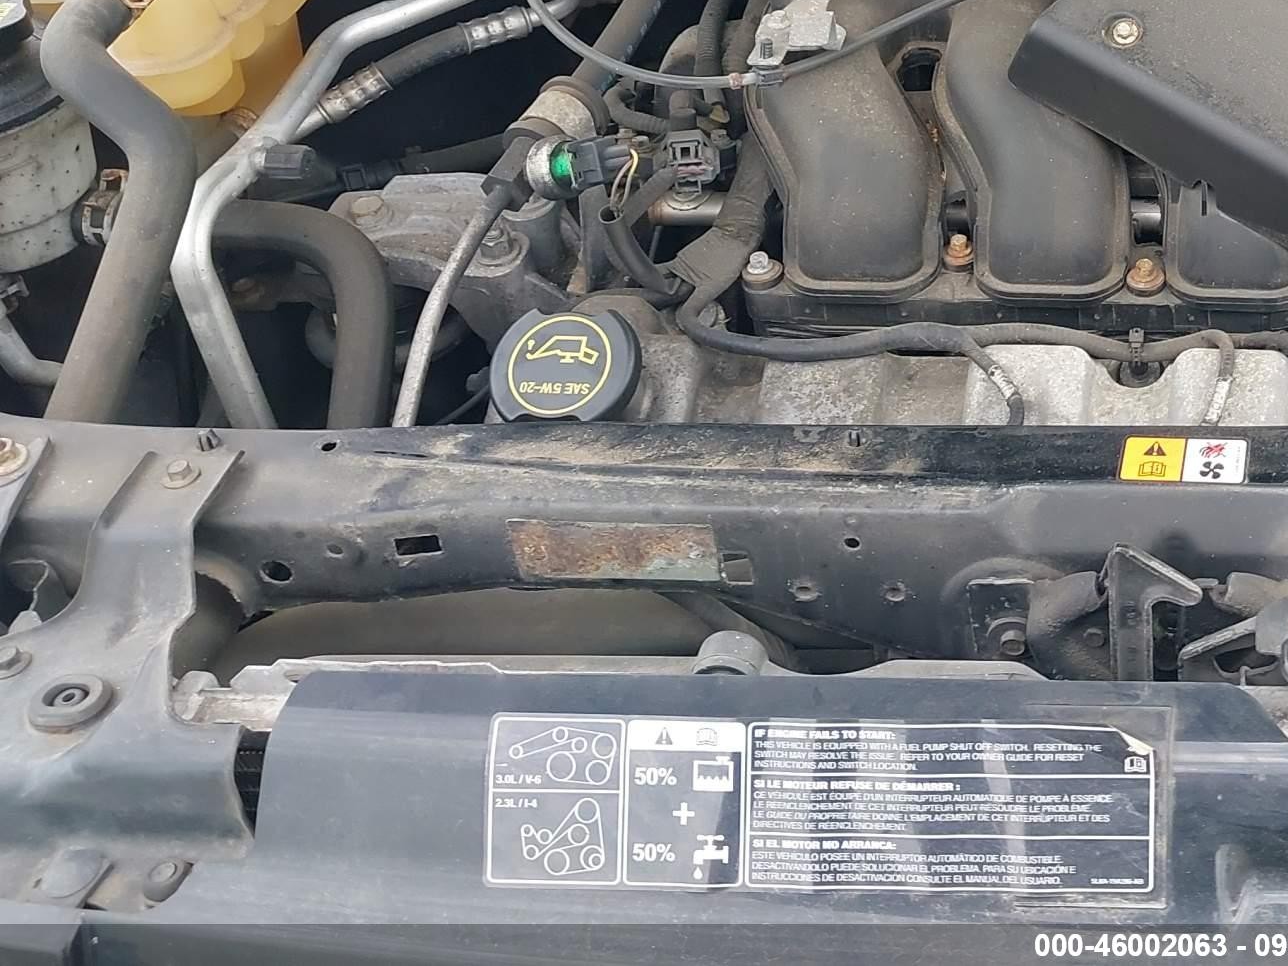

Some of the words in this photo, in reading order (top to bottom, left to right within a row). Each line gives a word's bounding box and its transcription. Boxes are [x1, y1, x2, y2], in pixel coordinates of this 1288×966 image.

[519, 381, 561, 394] 5W-20
[563, 383, 591, 395] SAE
[755, 729, 766, 738] IF
[809, 730, 839, 739] FAILS
[842, 730, 857, 739] TO
[859, 730, 896, 740] START:
[755, 741, 774, 749] THIS
[776, 741, 810, 749] VEHICLE
[824, 742, 867, 750] EQUIPPED
[869, 743, 892, 751] WITH
[899, 743, 921, 751] FUEL
[923, 743, 948, 751] PUMP
[950, 743, 973, 751] SHUT
[975, 743, 993, 751] OFF
[1034, 743, 1083, 751] RESETTING
[1086, 744, 1102, 752] THE
[755, 751, 787, 759] SWITCH
[790, 751, 807, 759] MAY
[808, 752, 848, 760] RESOLVE
[932, 753, 944, 761] TO
[945, 753, 970, 761] YOUR
[972, 753, 1004, 761] OWNER
[755, 760, 816, 769] INSTRUCTIONS
[495, 774, 517, 784] 3.0L
[525, 774, 542, 784] V-6
[634, 767, 677, 786] 50%
[754, 780, 764, 788] SI
[767, 780, 781, 788] LE
[783, 781, 828, 790] MOTEUR
[875, 782, 891, 790] DE
[754, 791, 767, 799] CE
[886, 793, 952, 803] INTERRUPTEUR
[953, 794, 1014, 803] AUTOMATIQUE
[1016, 795, 1028, 803] DE
[1030, 795, 1061, 803] POMPE
[495, 798, 517, 808] 2.3L
[887, 804, 953, 812] INTERRUPTEUR
[1029, 805, 1041, 813] LE
[767, 811, 792, 819] GUIDE
[873, 813, 903, 821] DONNE
[1010, 815, 1077, 823] INTERRUPTEUR
[1091, 815, 1110, 823] DES
[753, 821, 802, 829] DIRECTIVES
[753, 839, 763, 848] SI
[766, 840, 780, 848] EL
[782, 840, 820, 849] MOTOR
[822, 841, 839, 849] NO
[632, 844, 676, 863] 50%
[752, 851, 775, 859] ESTE
[820, 853, 850, 861] POSEE
[852, 853, 864, 861] UN
[866, 854, 926, 862] INTERRUPTOR
[830, 863, 860, 871] PUEDE
[862, 864, 917, 872] SOLUCIONAR
[919, 865, 930, 873] EL
[752, 872, 820, 881] INSTRUCCIONES
[907, 875, 952, 883] CONSULTE
[953, 875, 964, 883] EL
[1003, 876, 1019, 884] DEL
